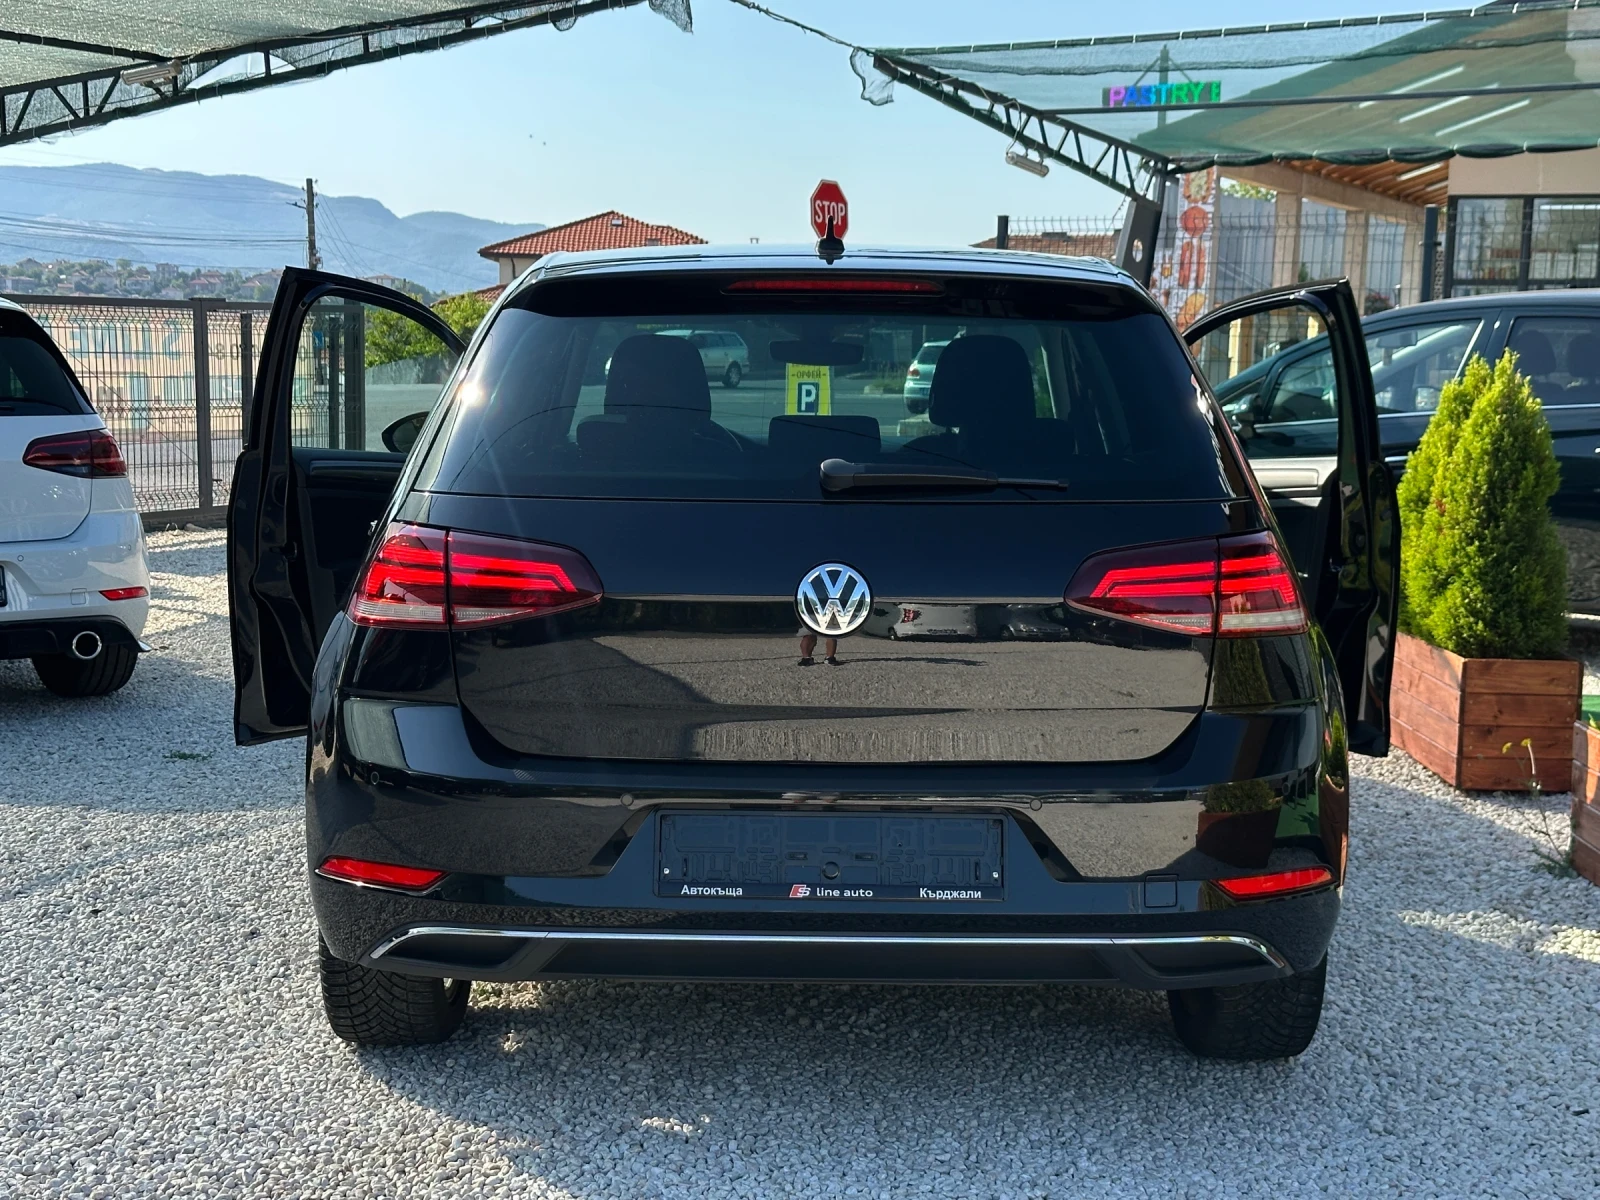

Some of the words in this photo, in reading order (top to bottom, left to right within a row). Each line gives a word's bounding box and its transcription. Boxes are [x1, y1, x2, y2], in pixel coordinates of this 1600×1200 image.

[1109, 80, 1205, 108] PASTRY
[814, 200, 846, 226] STOP
[801, 384, 817, 411] P
[797, 563, 870, 635] VW
[680, 884, 743, 897] Автокъща
[816, 887, 840, 897] line
[843, 888, 873, 897] auto
[919, 887, 982, 900] Кърджали
